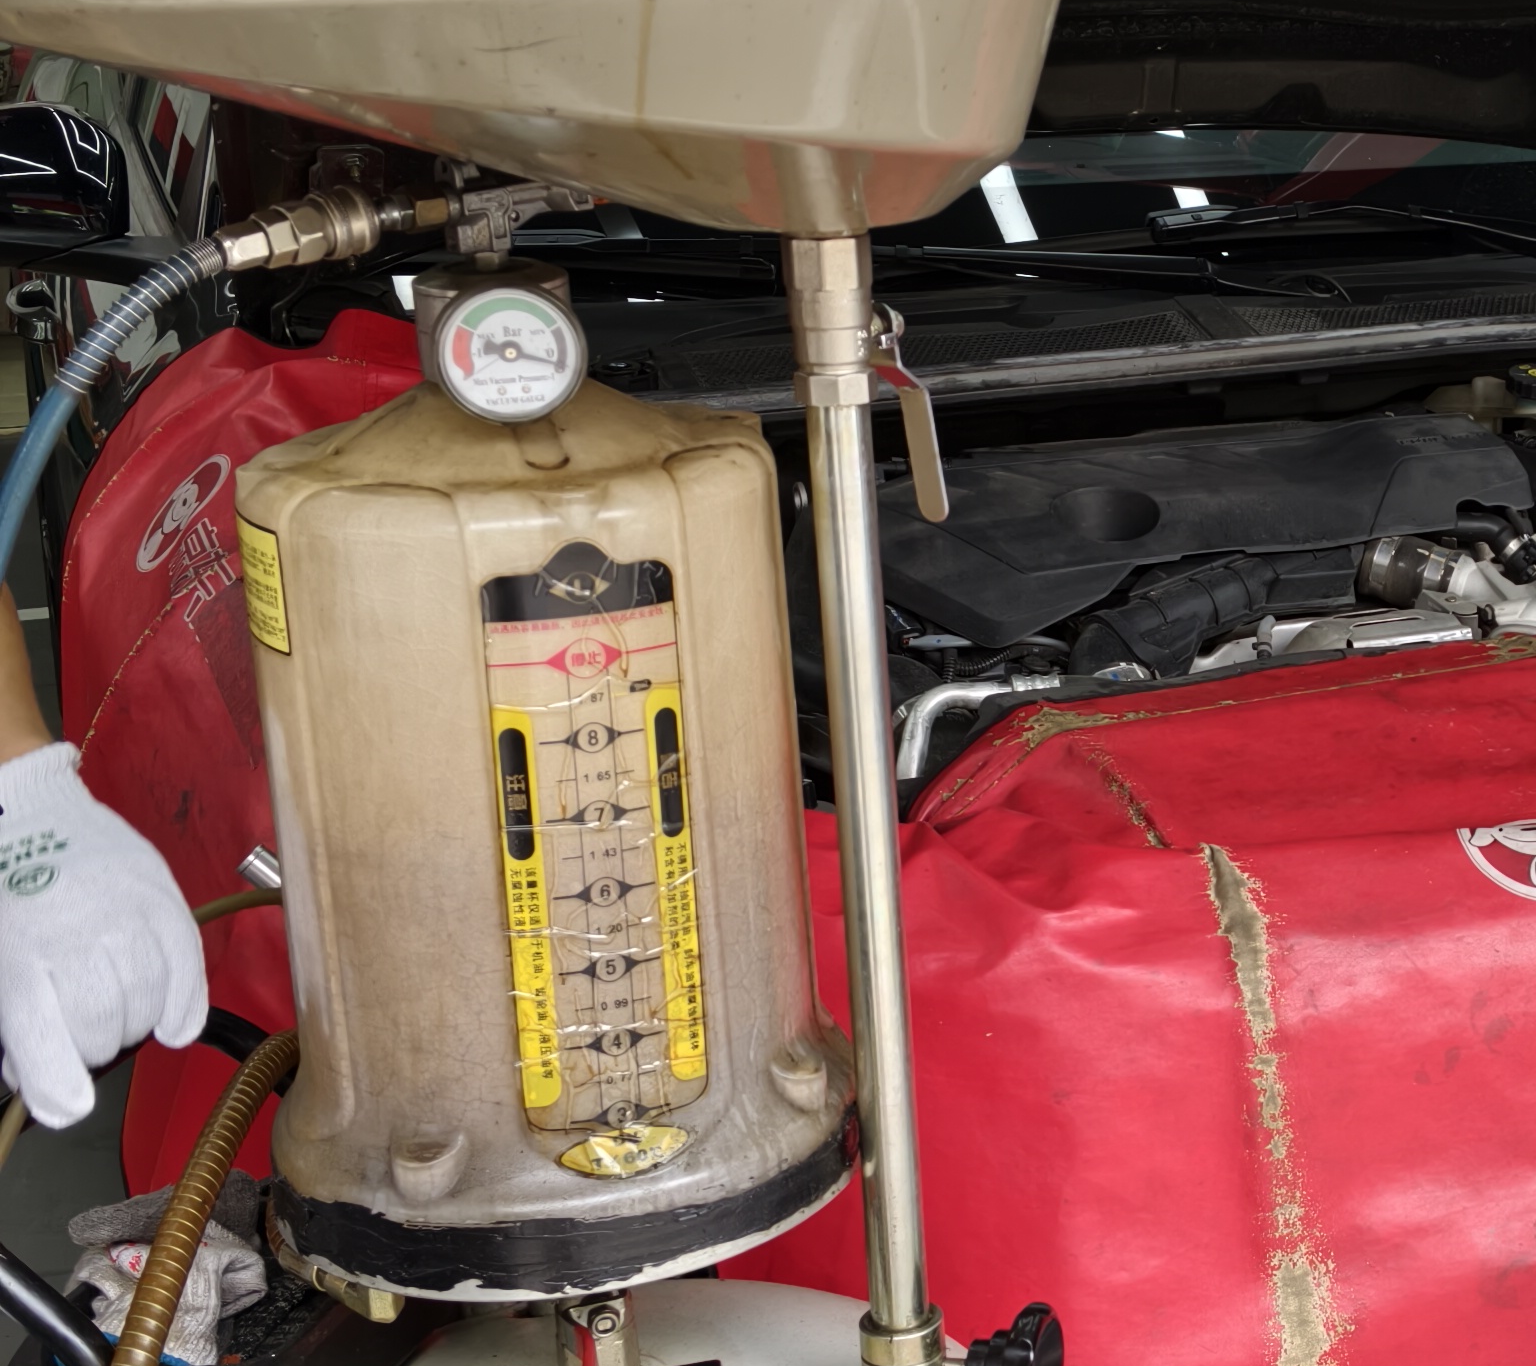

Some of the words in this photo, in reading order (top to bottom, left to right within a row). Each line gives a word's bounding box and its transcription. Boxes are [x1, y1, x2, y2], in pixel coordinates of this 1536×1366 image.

[502, 326, 523, 338] Bar
[587, 728, 600, 747] 8
[593, 807, 605, 823] 7
[599, 884, 612, 899] 6
[510, 867, 527, 937] 无腐蚀性液
[524, 866, 554, 1080] 该量杯仅适于机油、齿轮油、液压油等
[605, 959, 617, 976] 5
[610, 1032, 623, 1051] 4
[617, 1106, 628, 1124] 3
